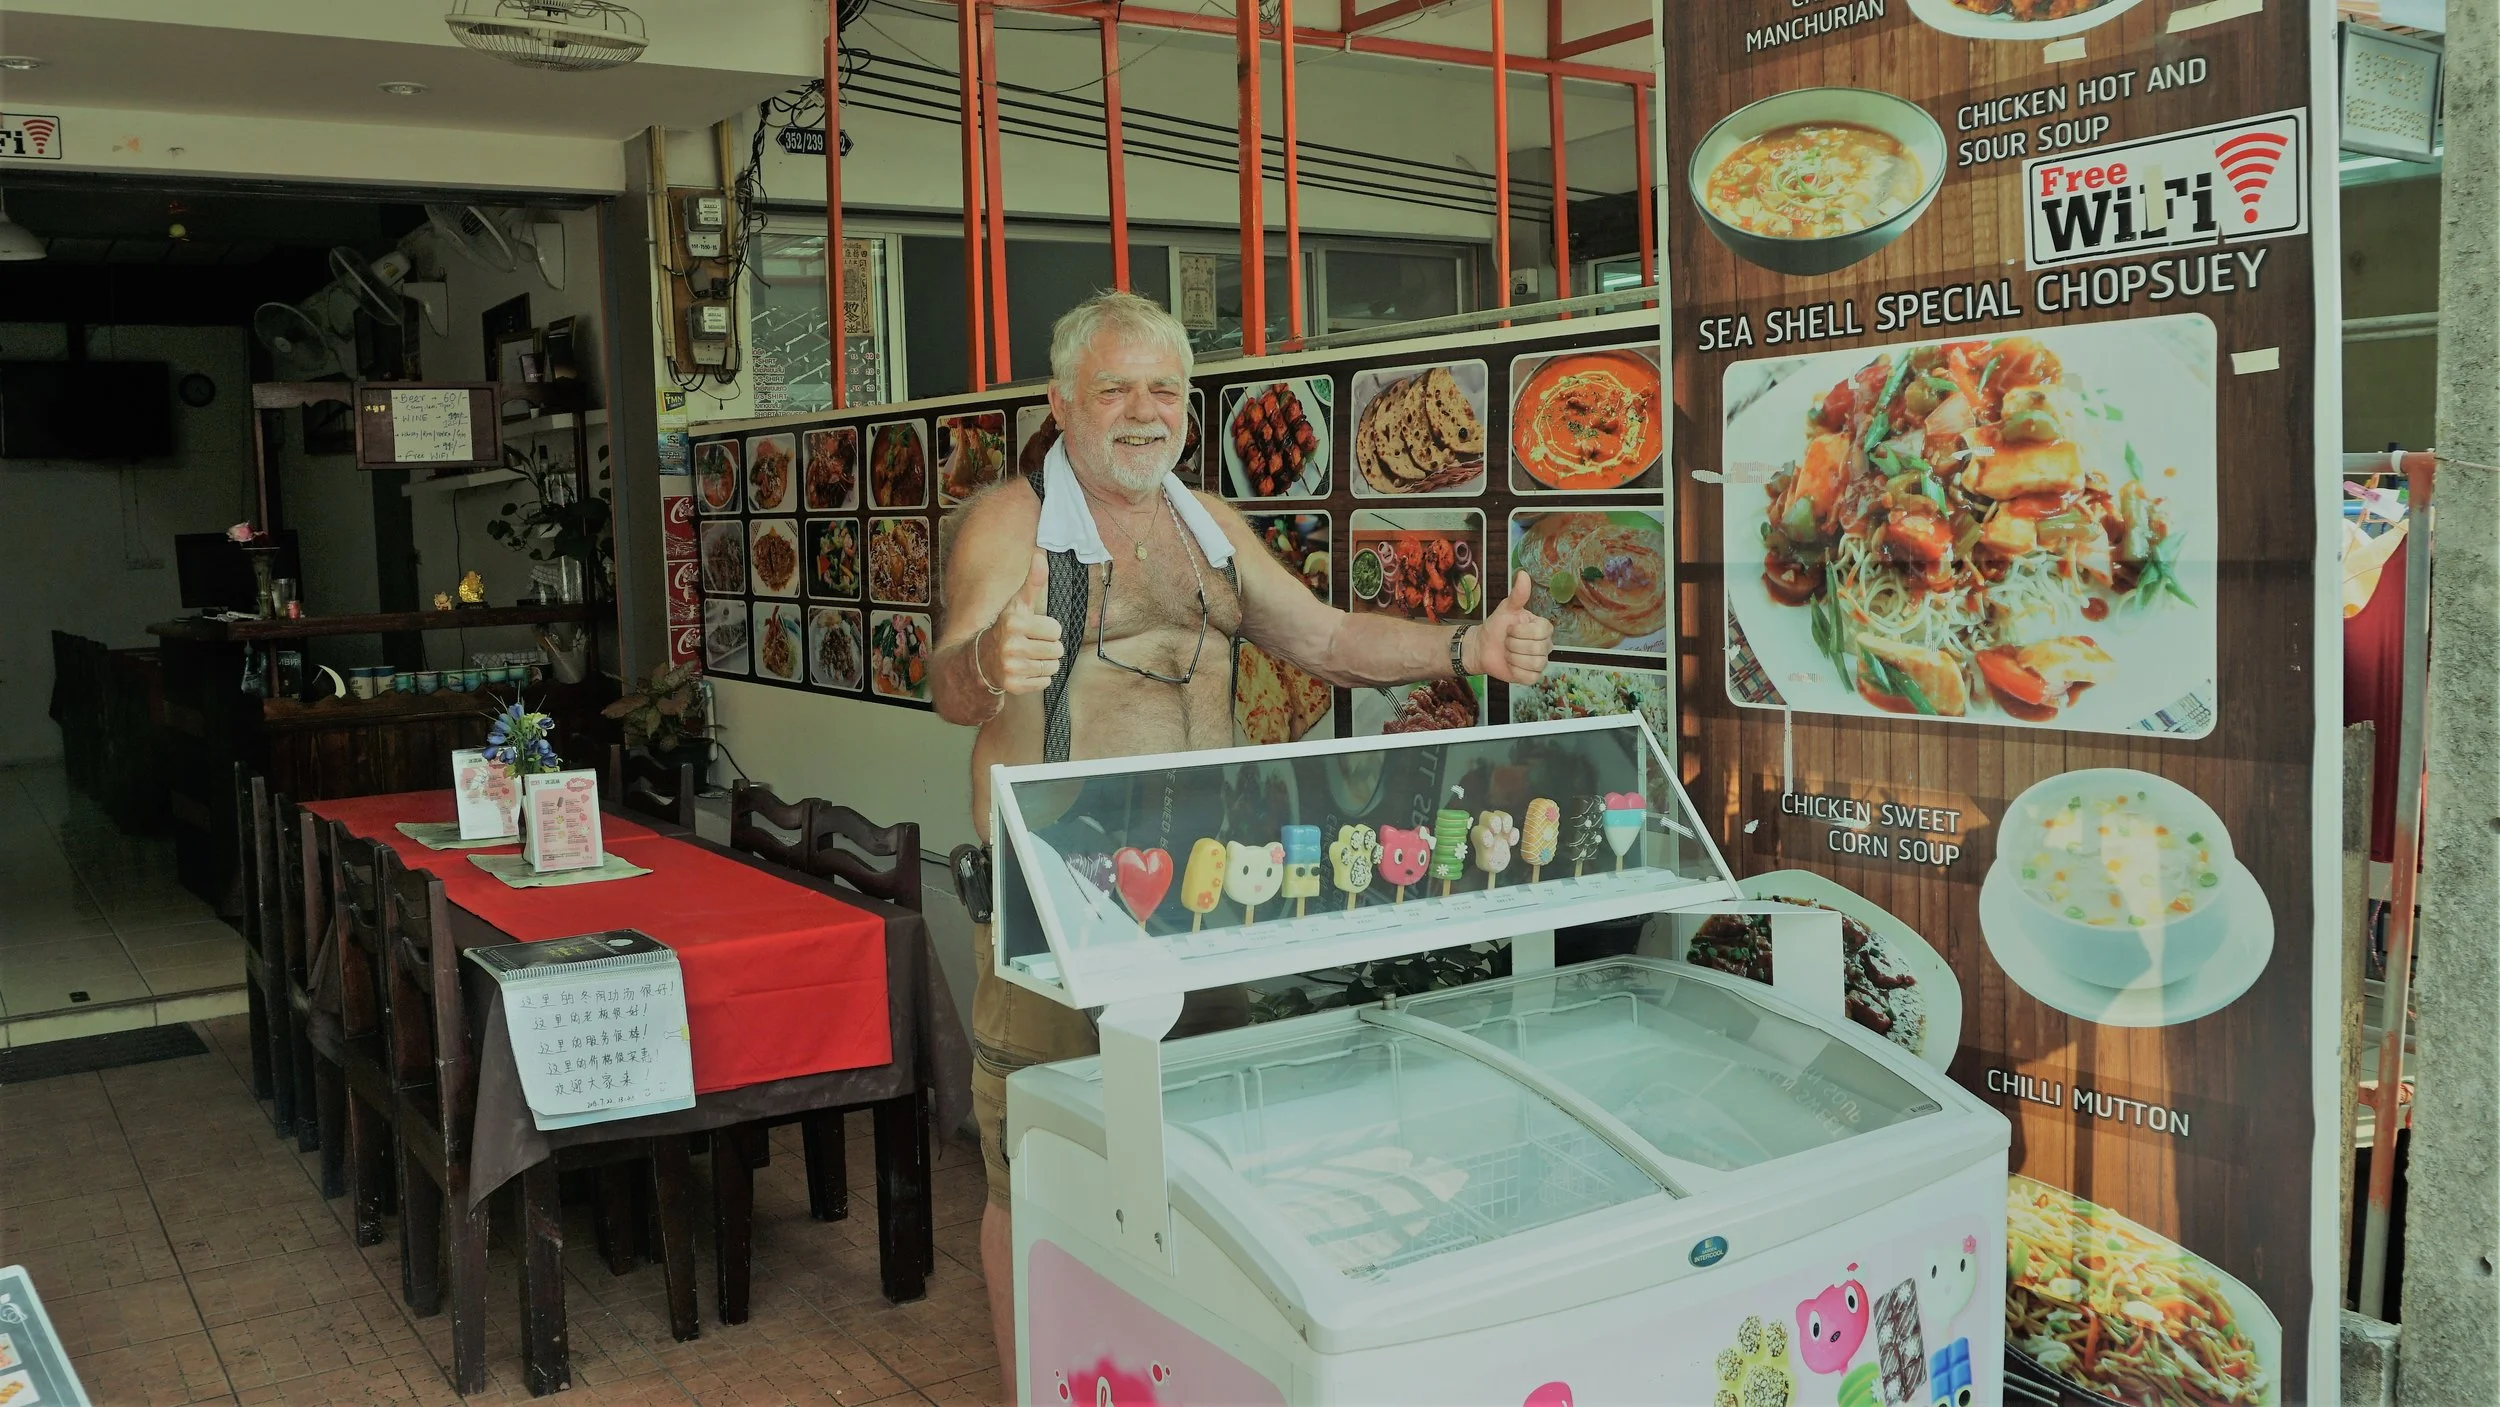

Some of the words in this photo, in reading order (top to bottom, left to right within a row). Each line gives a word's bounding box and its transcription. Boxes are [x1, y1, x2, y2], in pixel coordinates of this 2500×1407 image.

[1746, 0, 1884, 52] MANCHURIAN
[1958, 85, 2066, 131] CHICKEN
[2079, 71, 2136, 106] HOT
[2147, 57, 2207, 93] AND
[1958, 131, 2026, 166] SOUR
[2038, 115, 2110, 151] SOUP
[2040, 162, 2128, 197] Free
[1699, 316, 1753, 350] SEA
[1766, 302, 1863, 343] SHELL
[1876, 281, 2020, 331] SPECIAL
[2037, 248, 2267, 311] CHOPSUEY
[666, 395, 683, 405] TMN
[1781, 793, 1871, 823] CHICKEN
[1881, 804, 1960, 833] SWEET
[1829, 830, 1888, 858] CORN
[1899, 838, 1960, 866] SOUP
[1988, 1069, 2061, 1106] CHILLI
[2073, 1088, 2189, 1137] MUTTON
